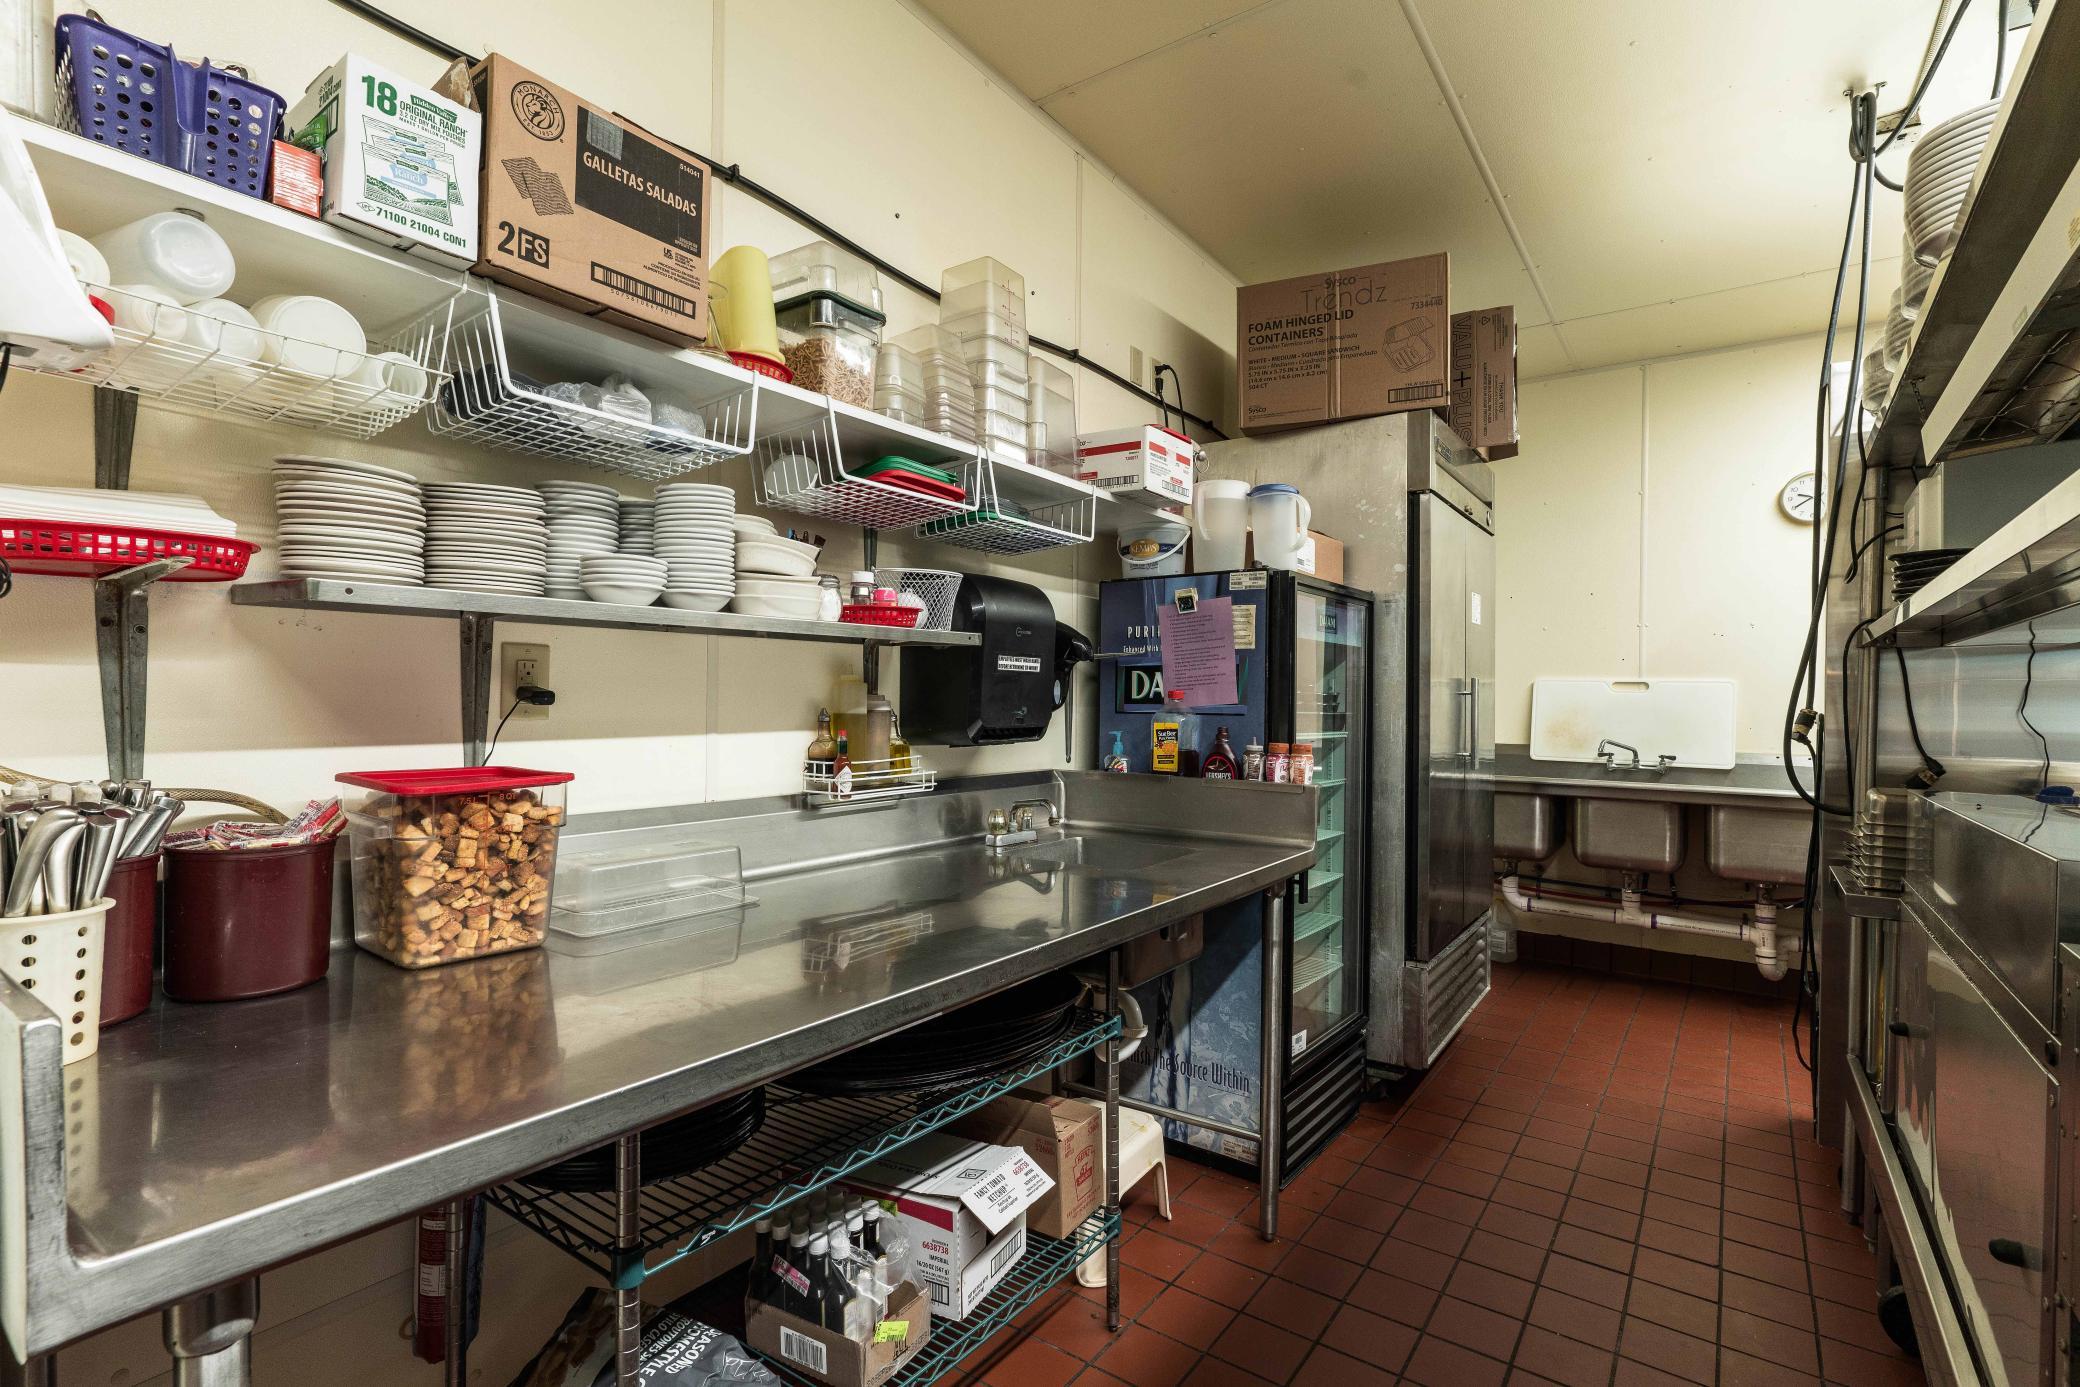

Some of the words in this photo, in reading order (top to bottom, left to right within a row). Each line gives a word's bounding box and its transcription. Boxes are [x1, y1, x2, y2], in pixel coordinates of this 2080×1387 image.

[362, 75, 398, 117] 18
[517, 85, 560, 114] MONARCH
[400, 100, 437, 126] ORIGINAL
[440, 118, 466, 138] RANCH
[410, 114, 417, 122] OZ
[419, 118, 430, 128] DRY
[431, 124, 441, 133] MIX
[443, 129, 466, 145] POUCHES
[679, 163, 700, 179] 514041
[583, 151, 644, 192] GALLETAS
[646, 181, 697, 217] SALADAS
[375, 206, 407, 226] 71100
[410, 219, 440, 239] 21004
[443, 231, 467, 248] CON1
[1325, 276, 1356, 290] Sysco
[1301, 279, 1387, 313] Trendz
[1248, 320, 1282, 333] FOAM
[1285, 313, 1331, 329] HINGED
[1334, 309, 1354, 321] LID
[1248, 327, 1324, 346] CONTAINERS
[1272, 353, 1297, 362] MEDIUM
[1301, 349, 1326, 359] SQUARE
[1248, 407, 1267, 415] Sysco
[1146, 644, 1159, 652] With
[1154, 1047, 1171, 1071] The
[1173, 1053, 1208, 1082] Source
[1211, 1062, 1251, 1092] Within
[973, 1185, 990, 1199] FANCY
[986, 1173, 1006, 1190] TOMATO
[987, 1185, 1008, 1203] KETCHUP
[922, 1241, 949, 1256] 6638738
[929, 1254, 949, 1265] IMPERIAL
[648, 1317, 693, 1354] ROUTONES
